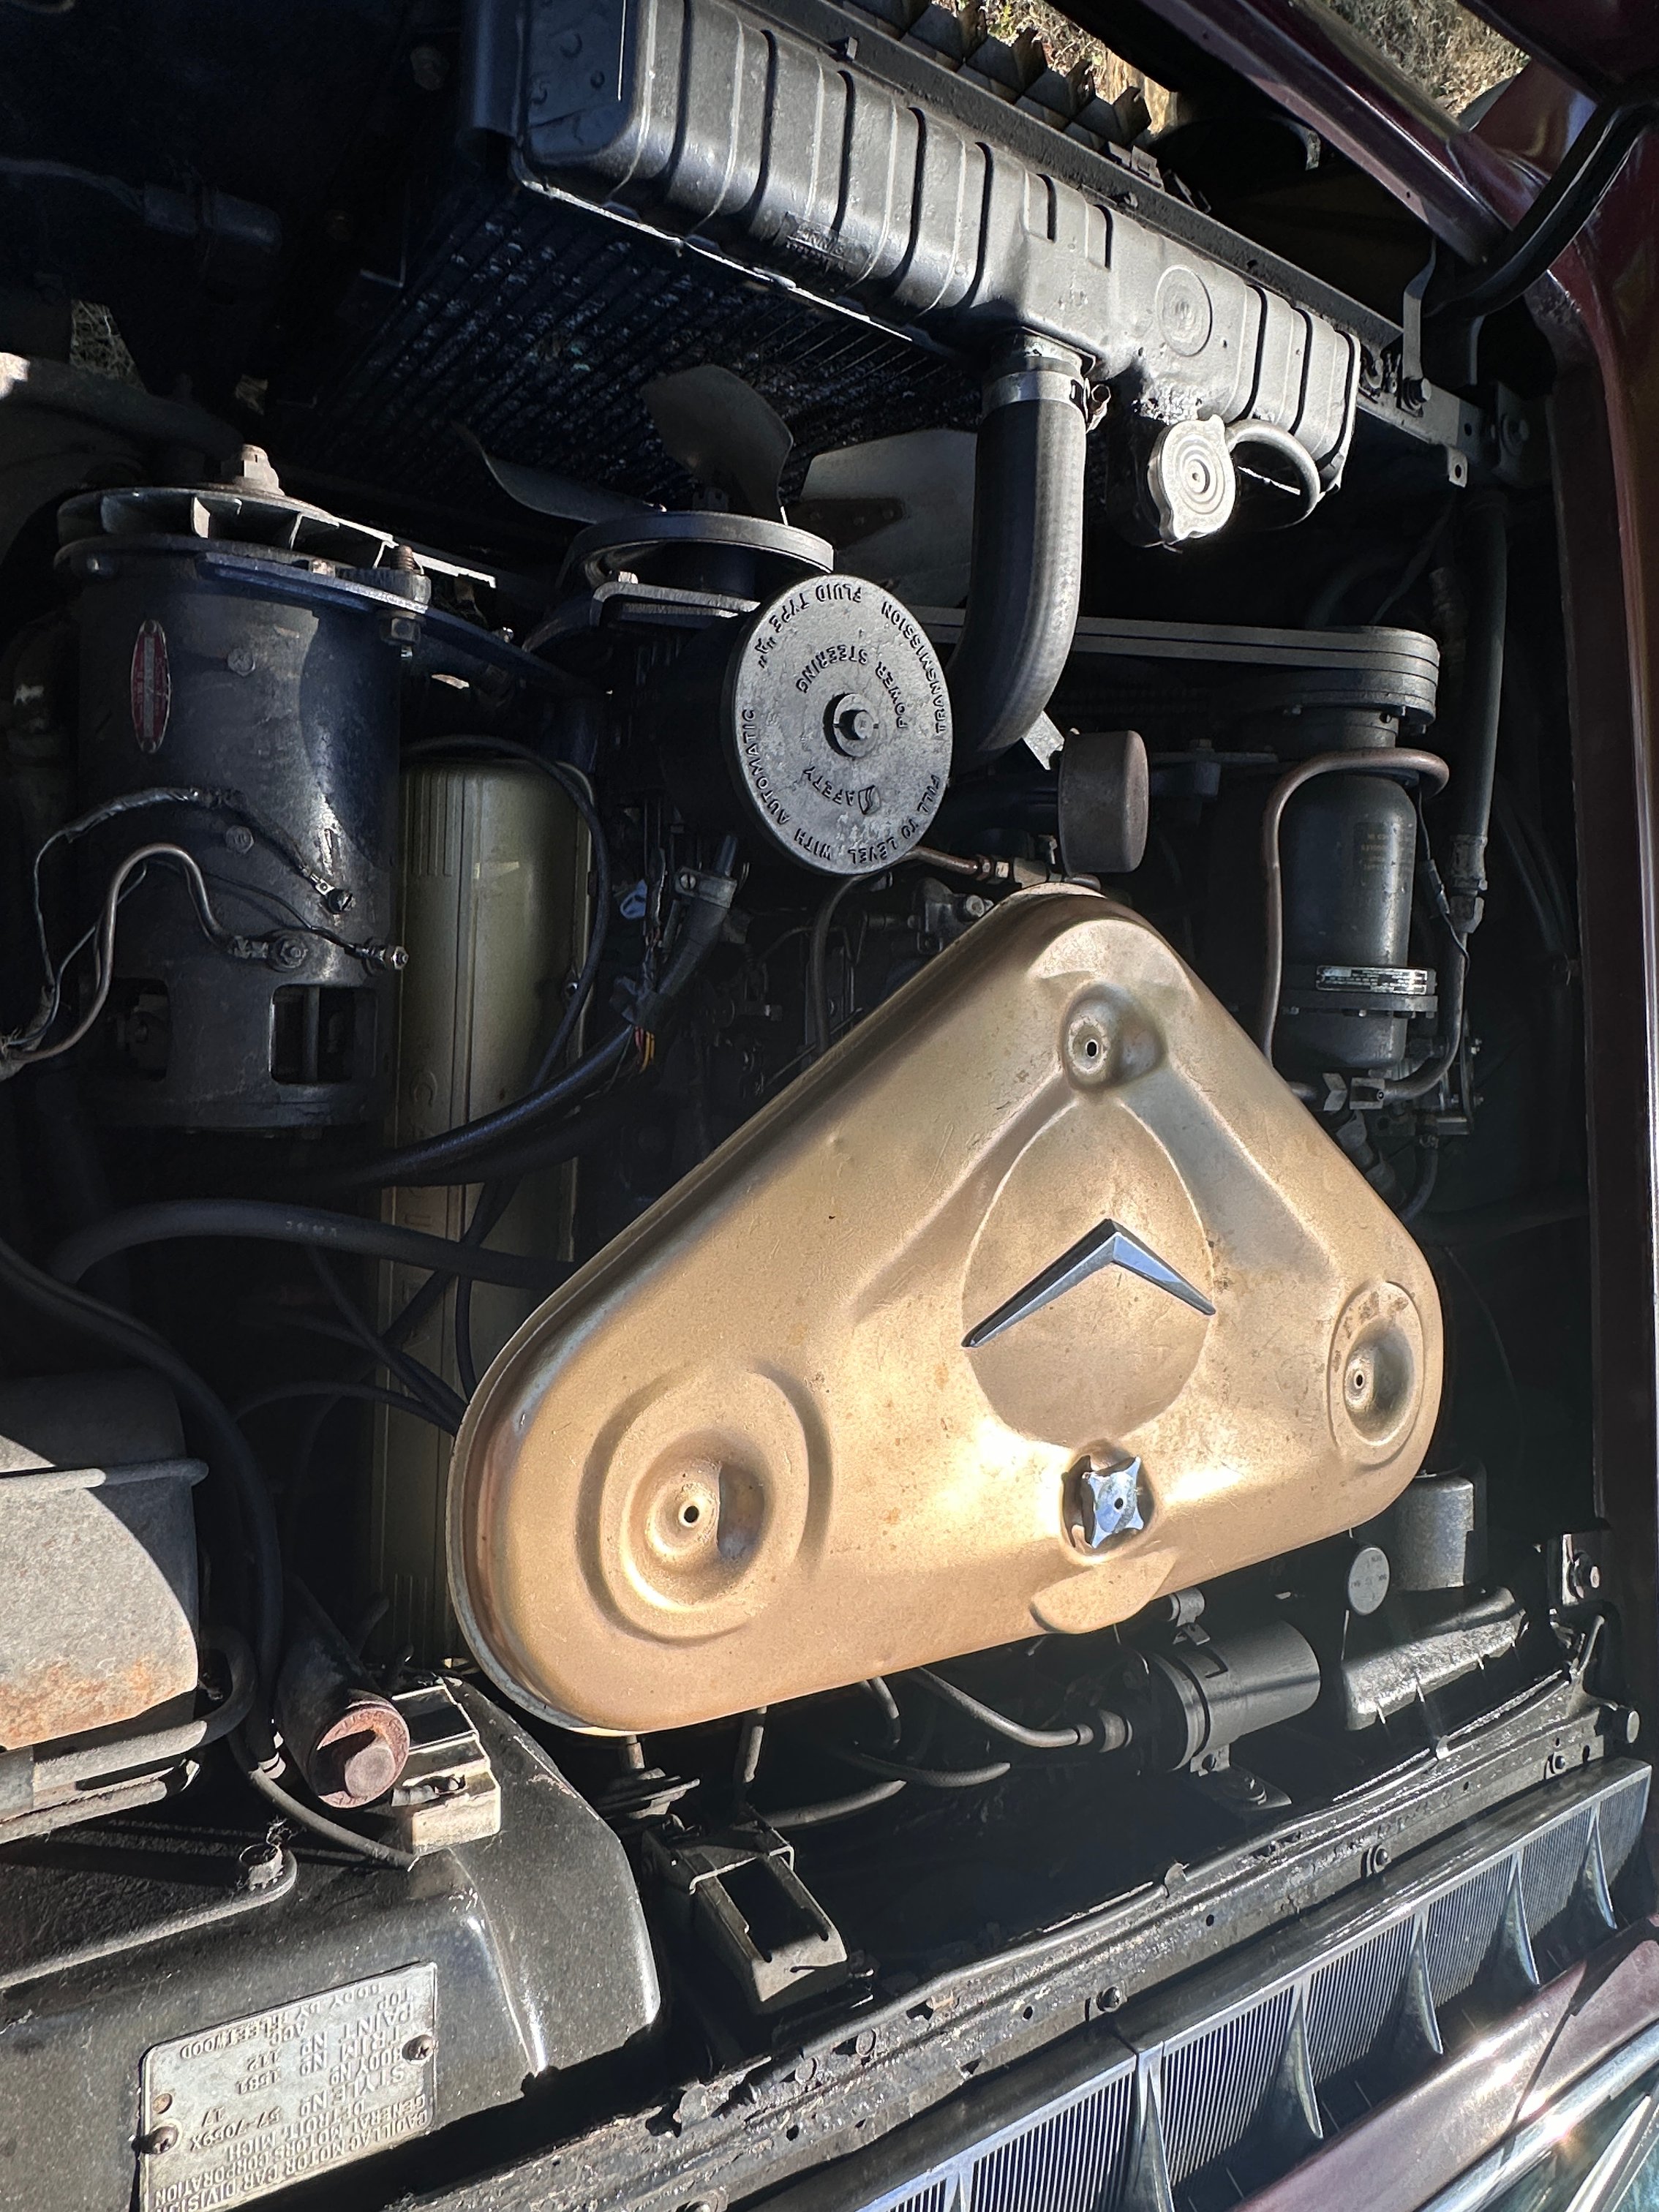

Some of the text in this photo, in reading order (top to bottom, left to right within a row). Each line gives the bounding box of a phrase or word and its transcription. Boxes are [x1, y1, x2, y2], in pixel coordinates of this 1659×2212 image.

[768, 592, 810, 633] TYPE
[816, 583, 862, 603] FLUID
[796, 644, 868, 693] STEERING
[881, 601, 947, 734] TRANSMISSION
[874, 661, 911, 729] POWER
[742, 708, 791, 826] AUTOMATIC
[917, 775, 941, 814] FILL
[794, 828, 832, 862] WITH
[900, 818, 919, 840] TO
[847, 835, 898, 865] LEVEL
[377, 1987, 412, 2011] TOP
[344, 2002, 414, 2039] PAINT
[339, 2025, 401, 2062] TRIM
[355, 2047, 403, 2077] BODY
[331, 2065, 405, 2105] STYLE
[155, 2094, 426, 2208] GENERAL MOTORS CORPORATION
[156, 2109, 428, 2212] CADILLAC MOTOR CAR DIVISIO
